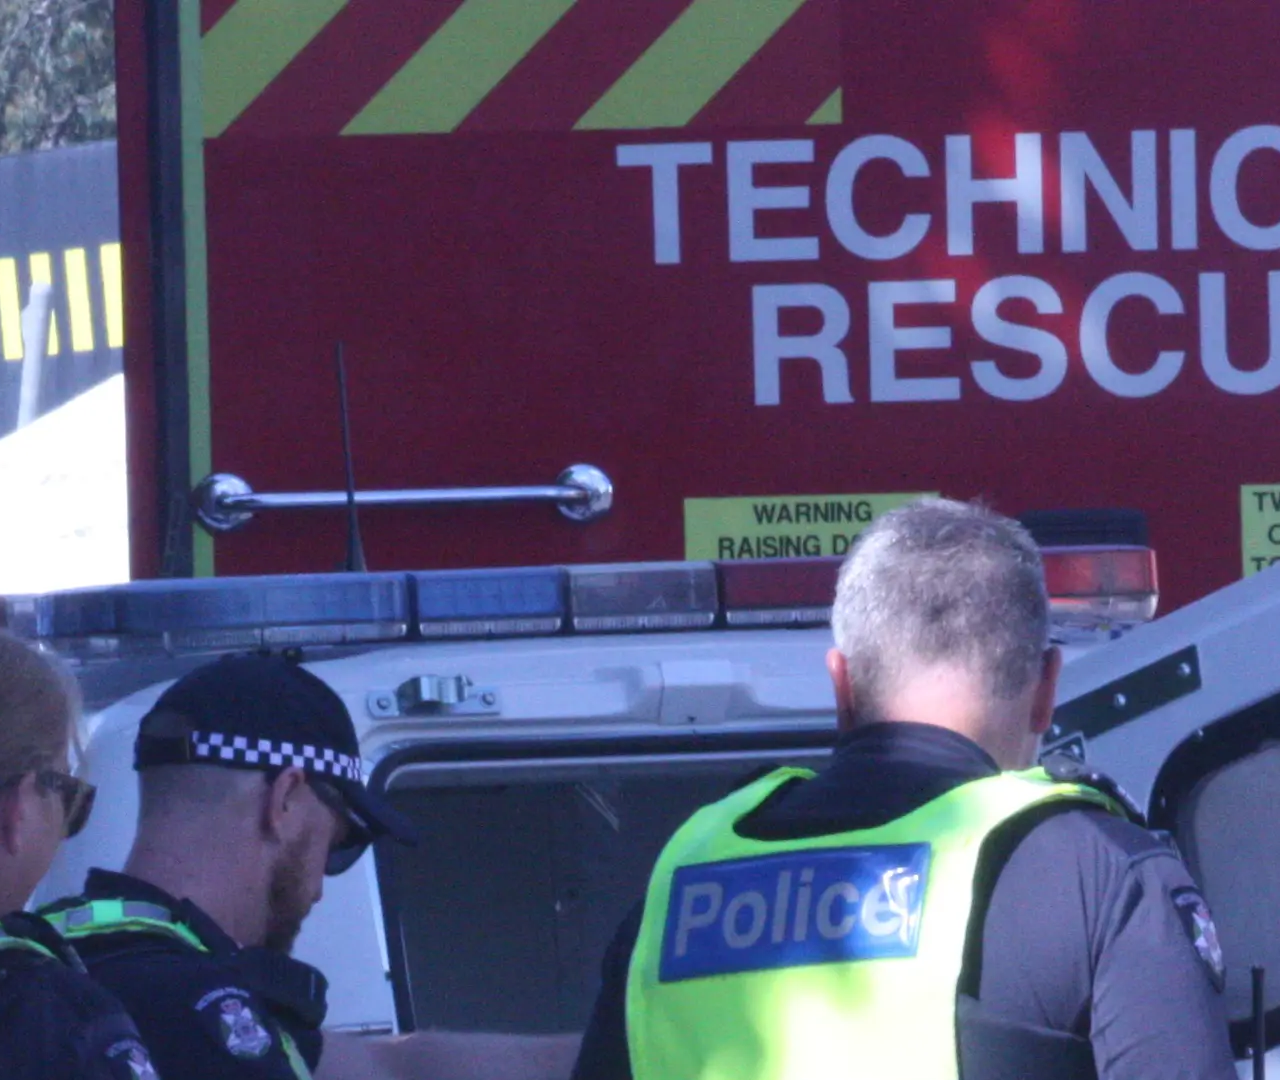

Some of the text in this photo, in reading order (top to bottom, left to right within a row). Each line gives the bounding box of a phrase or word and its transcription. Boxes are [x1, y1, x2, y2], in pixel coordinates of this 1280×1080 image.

[753, 501, 873, 525] WARNING
[718, 535, 822, 560] RAISING
[672, 867, 920, 958] Police
